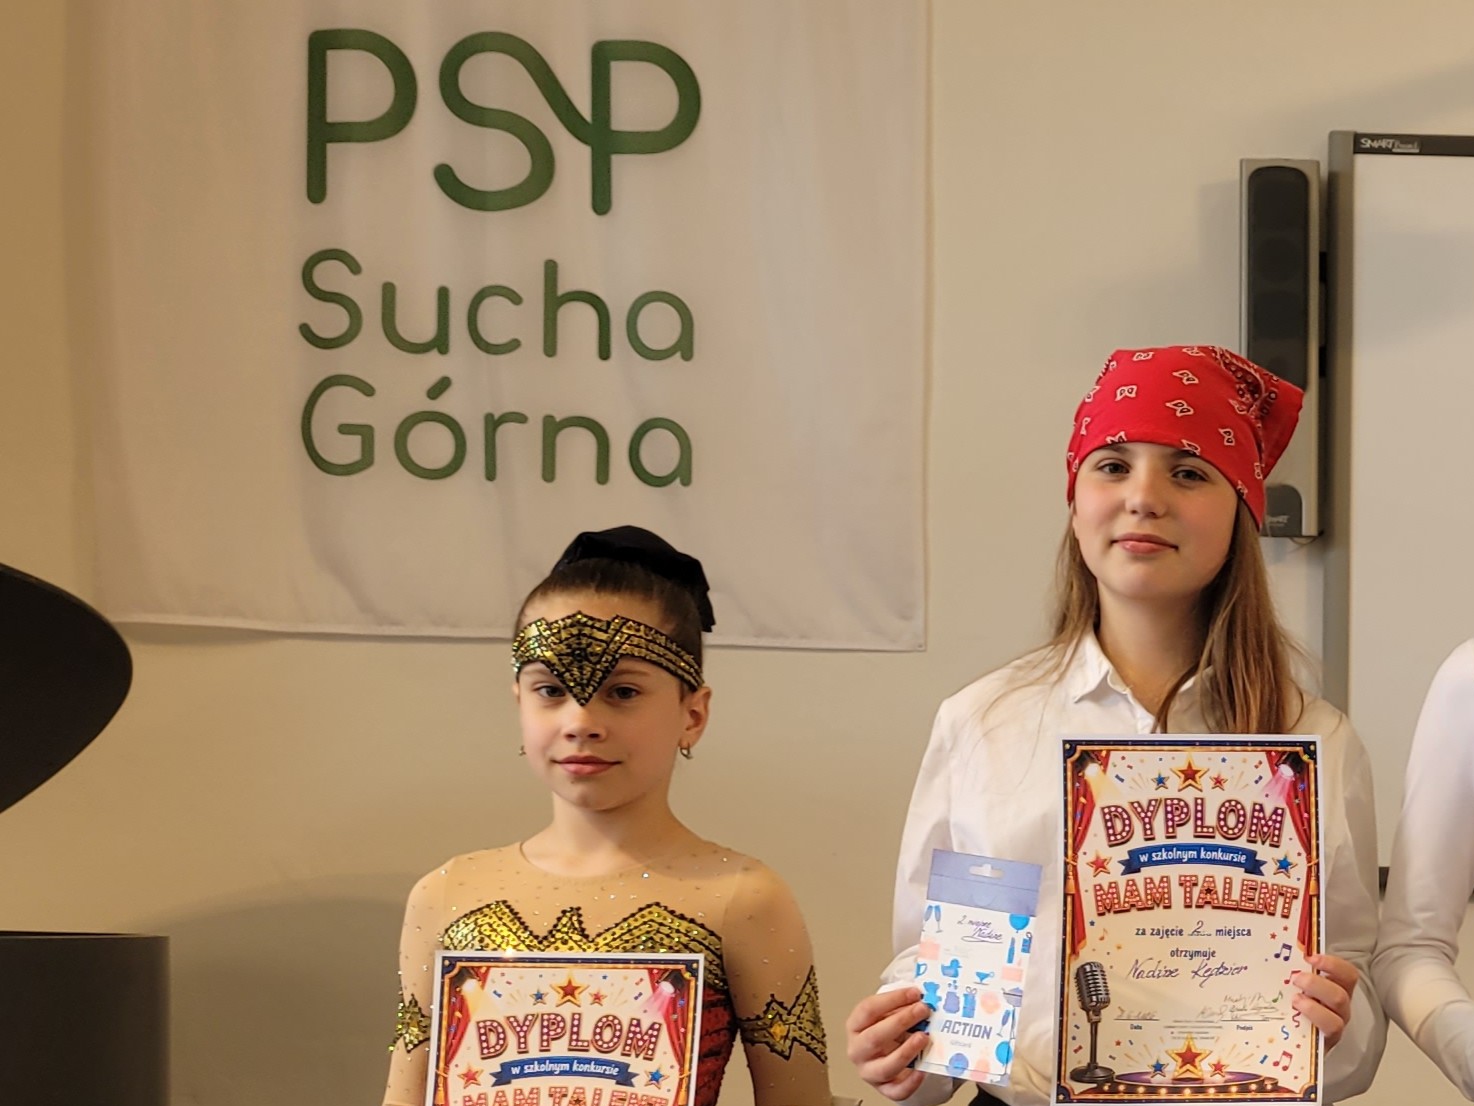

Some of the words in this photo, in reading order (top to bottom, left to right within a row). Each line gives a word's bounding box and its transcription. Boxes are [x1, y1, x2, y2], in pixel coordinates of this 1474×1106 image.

[307, 28, 701, 216] PSP
[299, 248, 693, 361] Sucha
[301, 374, 692, 487] Górna
[1101, 796, 1286, 847] DYPLOM
[1139, 852, 1149, 863] w
[1152, 848, 1197, 865] szkolnym
[1200, 847, 1247, 864] konkursie
[1093, 875, 1172, 917] MAM
[1178, 874, 1300, 918] TALENT
[1135, 927, 1147, 937] za
[1150, 925, 1184, 940] zajęcie
[1215, 925, 1252, 940] miejsca
[1170, 947, 1217, 961] otrzymuje
[476, 1012, 662, 1060] DYPLOM
[940, 1019, 992, 1040] ACTION
[511, 1066, 520, 1076] w
[523, 1060, 570, 1076] szkolnym
[572, 1060, 620, 1076] konkursie
